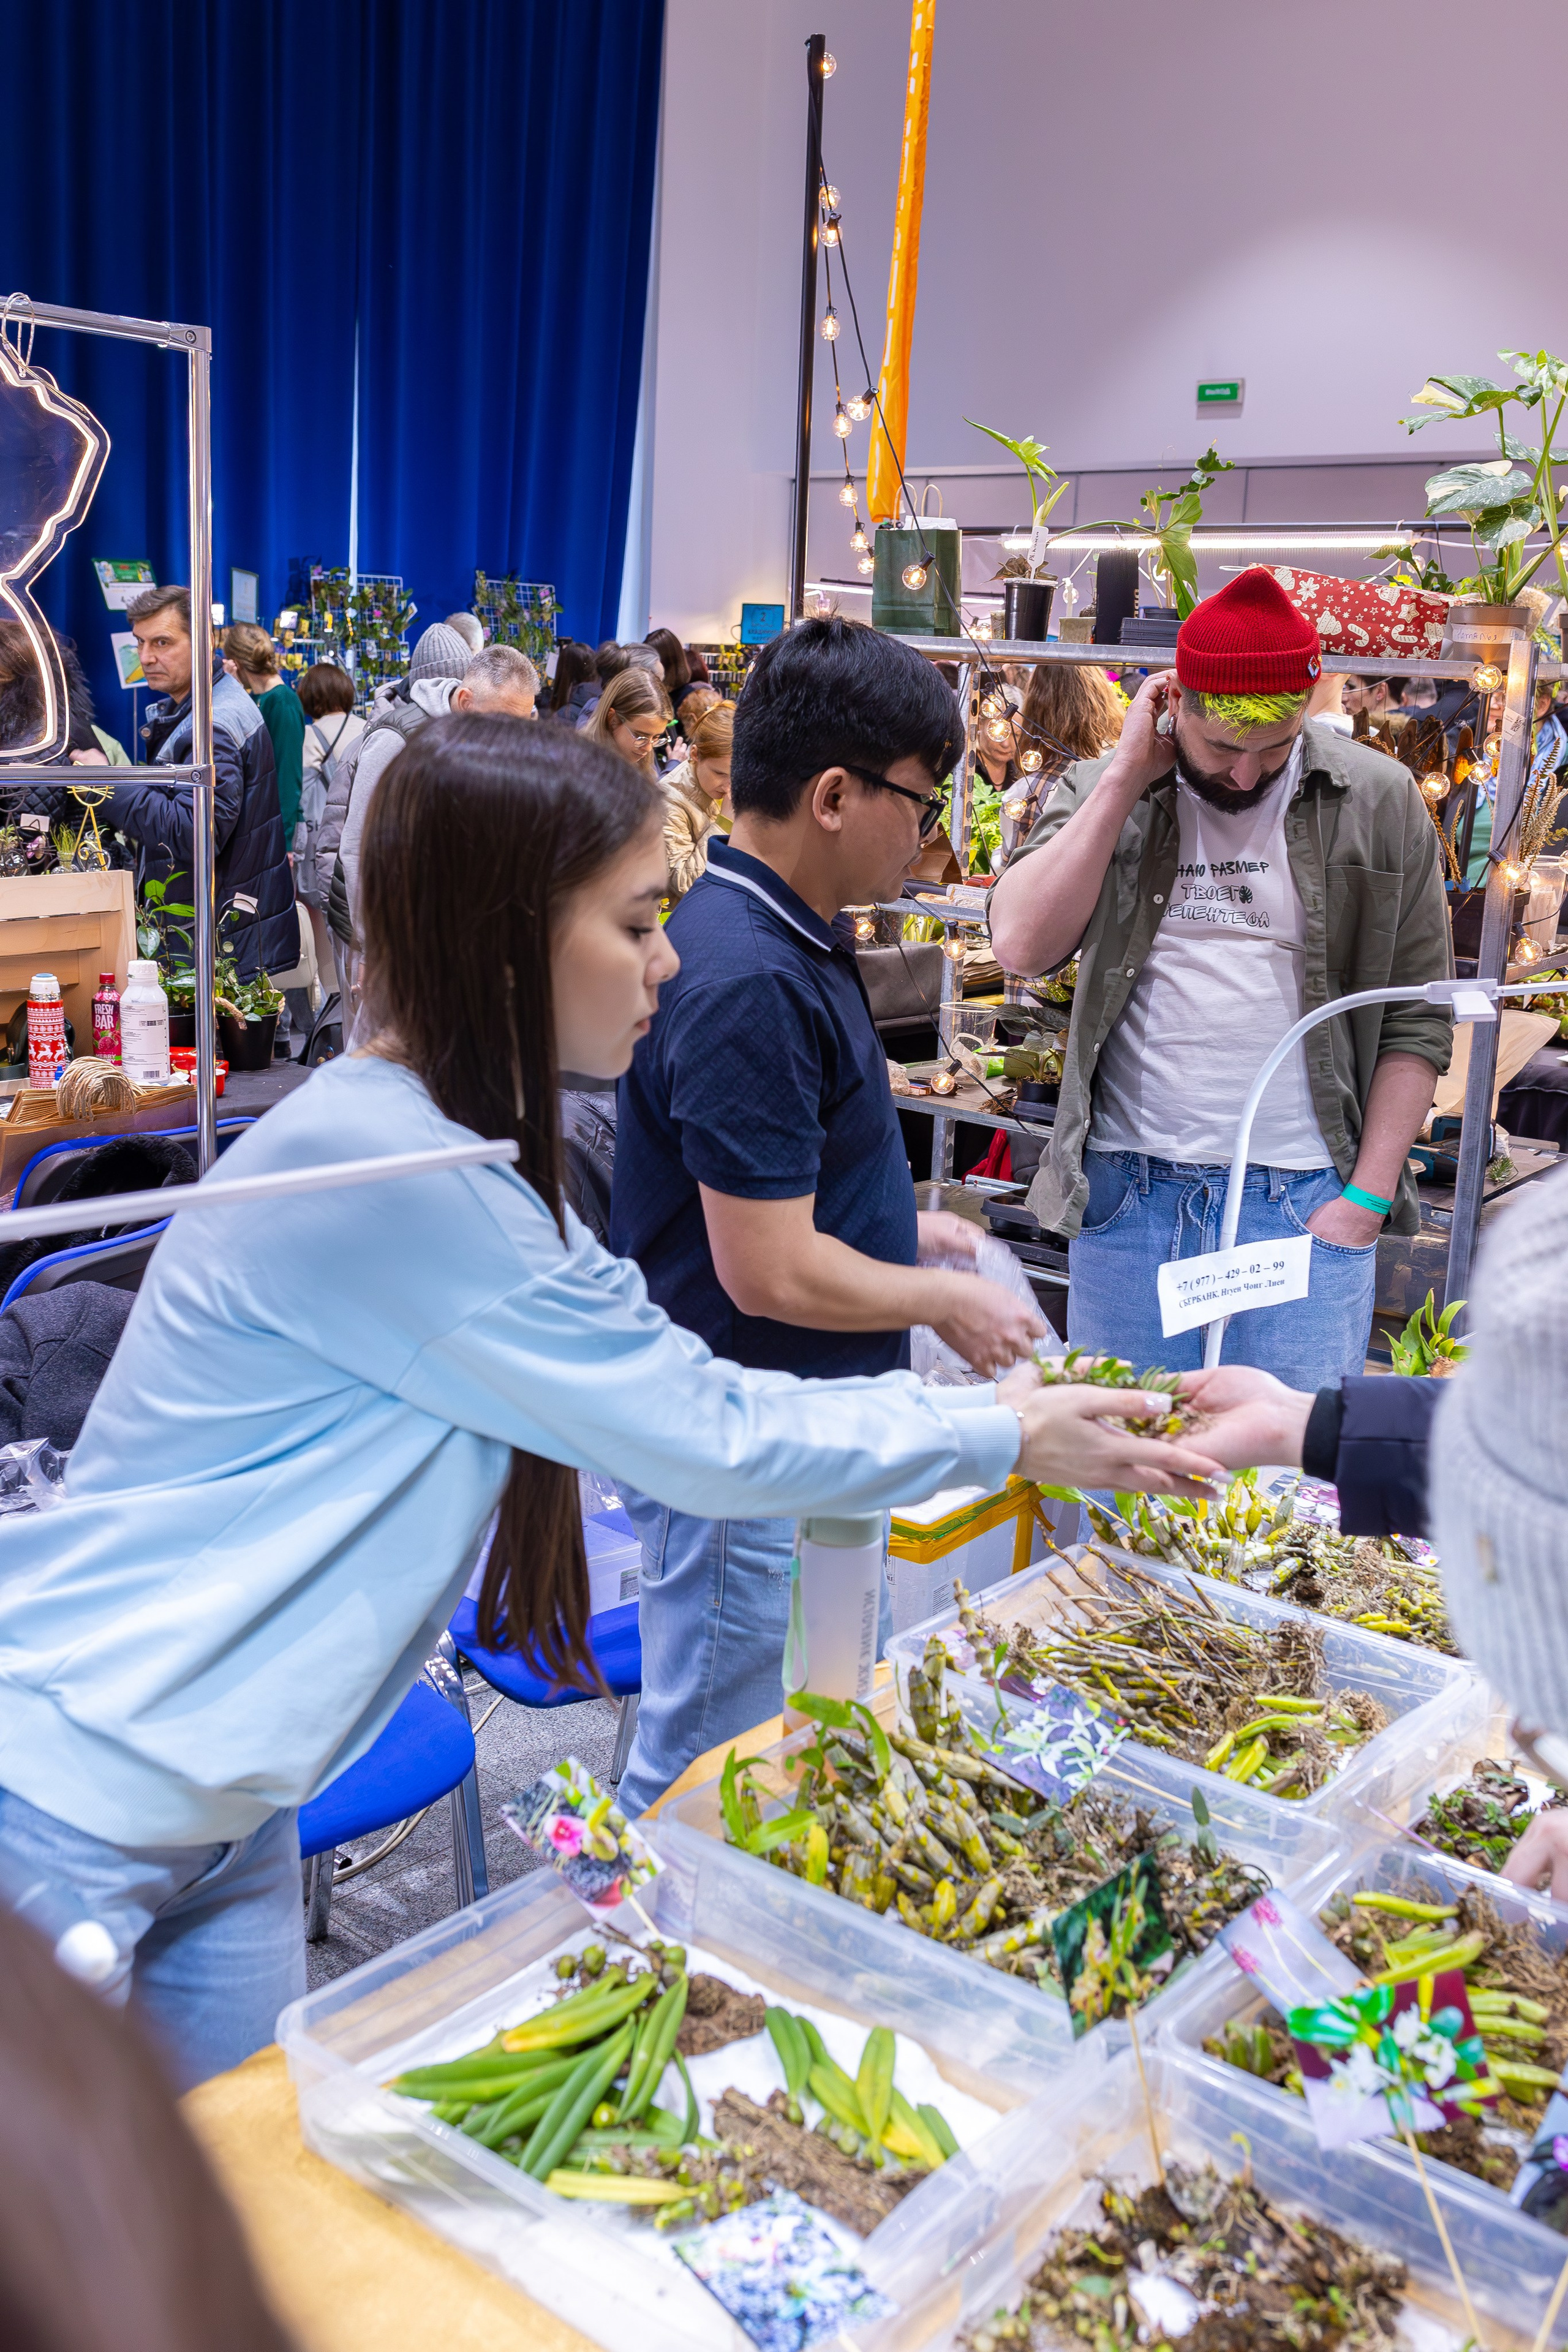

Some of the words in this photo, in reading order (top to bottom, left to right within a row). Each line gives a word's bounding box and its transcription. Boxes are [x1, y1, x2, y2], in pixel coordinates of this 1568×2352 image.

[1175, 864, 1205, 878] НАЮ
[1210, 861, 1269, 878] РАЗМЕР
[94, 1003, 114, 1015] FRESH
[95, 1014, 115, 1030] BAR
